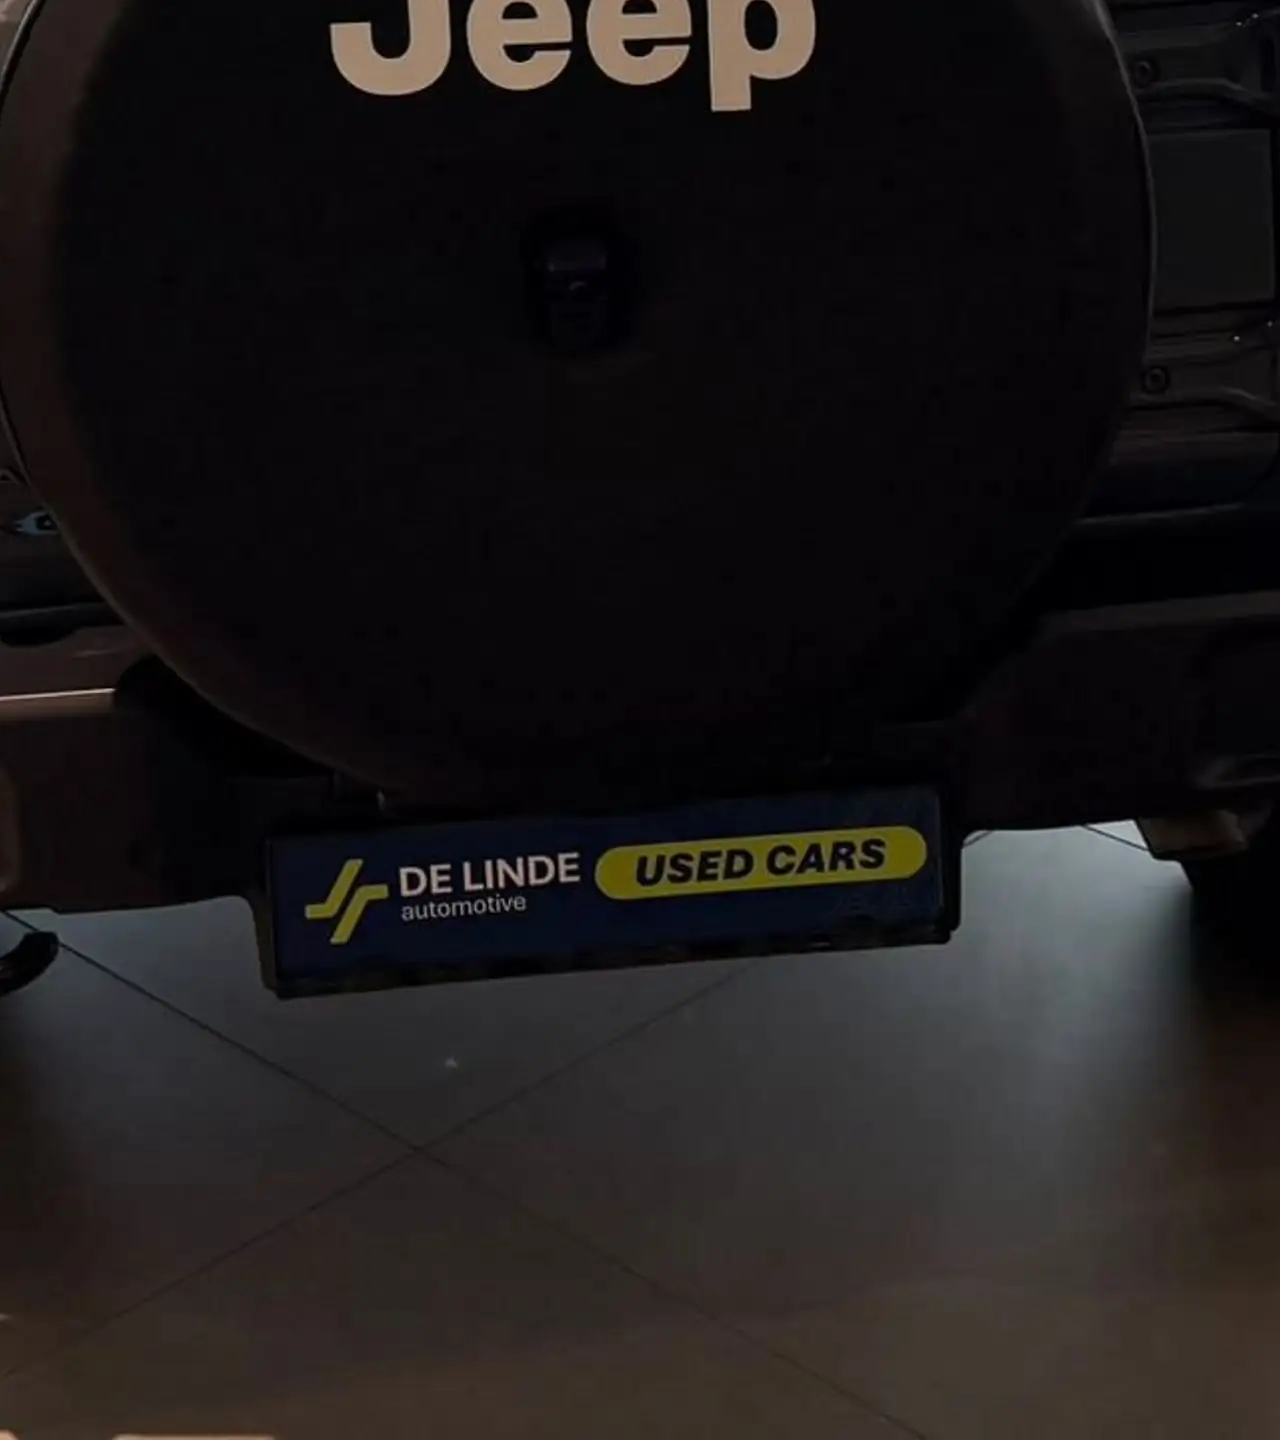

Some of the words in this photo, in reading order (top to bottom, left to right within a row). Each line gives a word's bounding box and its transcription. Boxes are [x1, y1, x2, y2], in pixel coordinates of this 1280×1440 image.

[398, 863, 454, 898] DE
[463, 851, 582, 894] LINDE
[635, 841, 756, 888] USED
[767, 836, 887, 879] CARS
[400, 893, 528, 923] automotive
